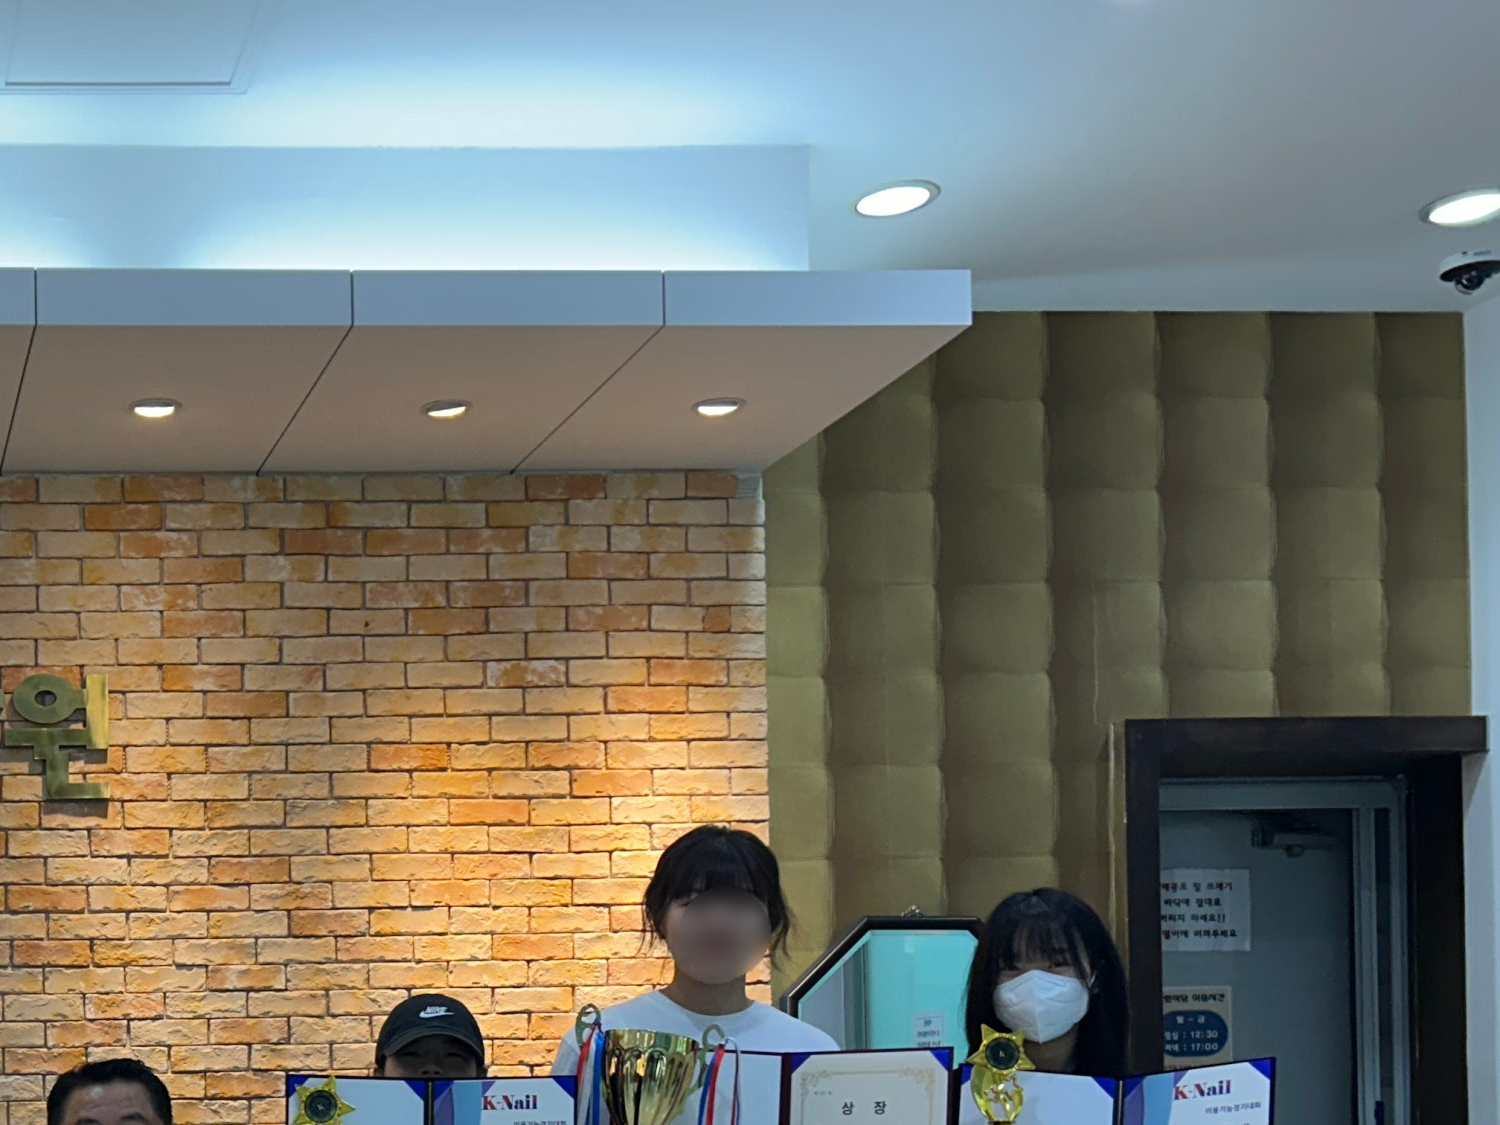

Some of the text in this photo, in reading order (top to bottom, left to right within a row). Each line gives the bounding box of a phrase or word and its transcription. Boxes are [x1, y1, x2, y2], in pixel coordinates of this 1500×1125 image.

[425, 1006, 457, 1014] NIKE
[1191, 1043, 1218, 1051] 17:00
[1174, 1080, 1231, 1100] K-Nail
[482, 1094, 538, 1111] K-Nail
